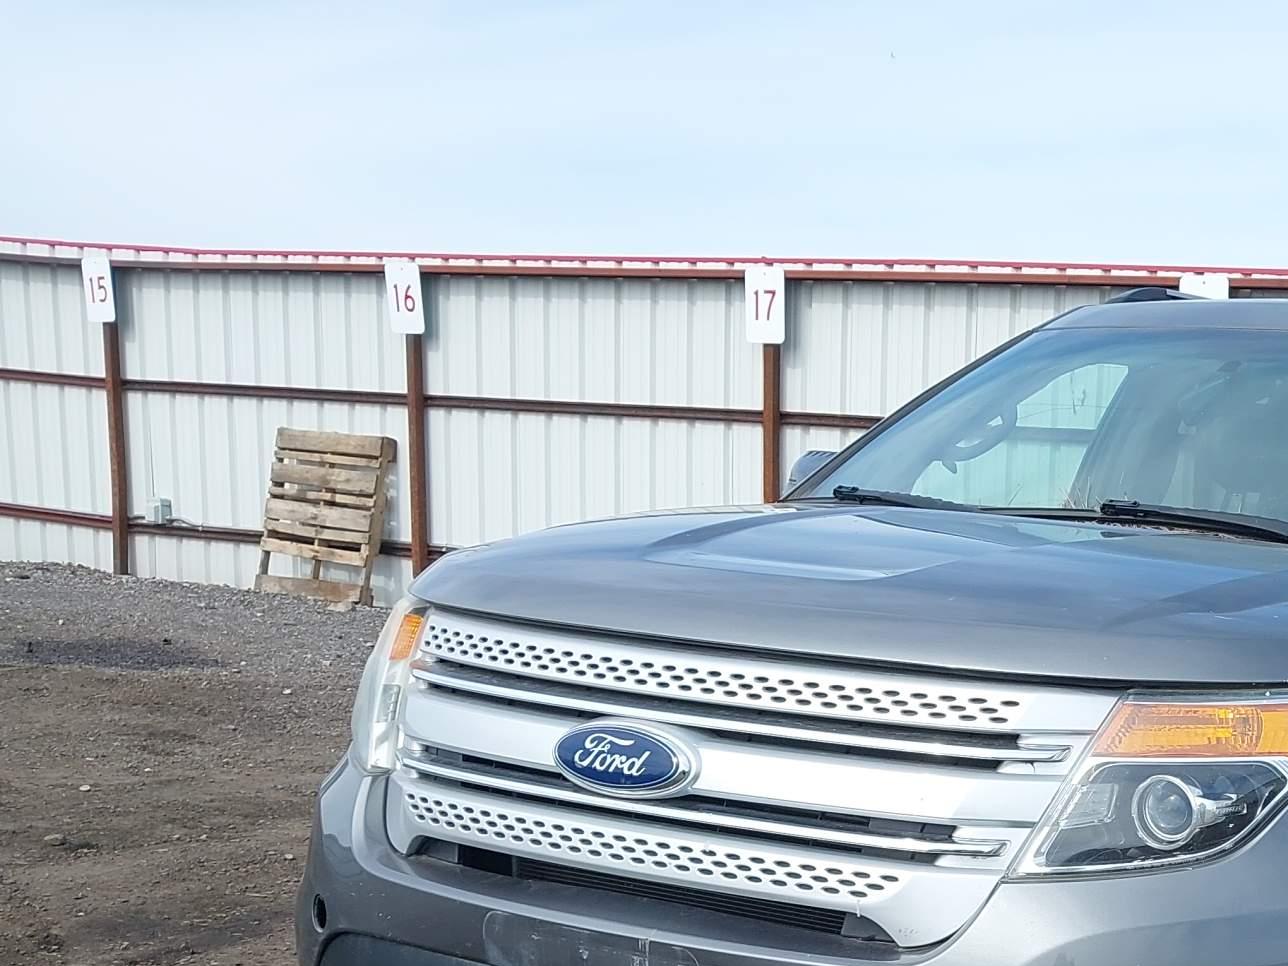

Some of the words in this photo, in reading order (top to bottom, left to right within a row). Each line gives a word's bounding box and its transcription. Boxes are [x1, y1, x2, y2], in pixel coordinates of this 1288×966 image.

[88, 275, 108, 304] 15
[393, 283, 416, 313] 16
[753, 289, 777, 321] 17
[574, 733, 651, 777] Ford
